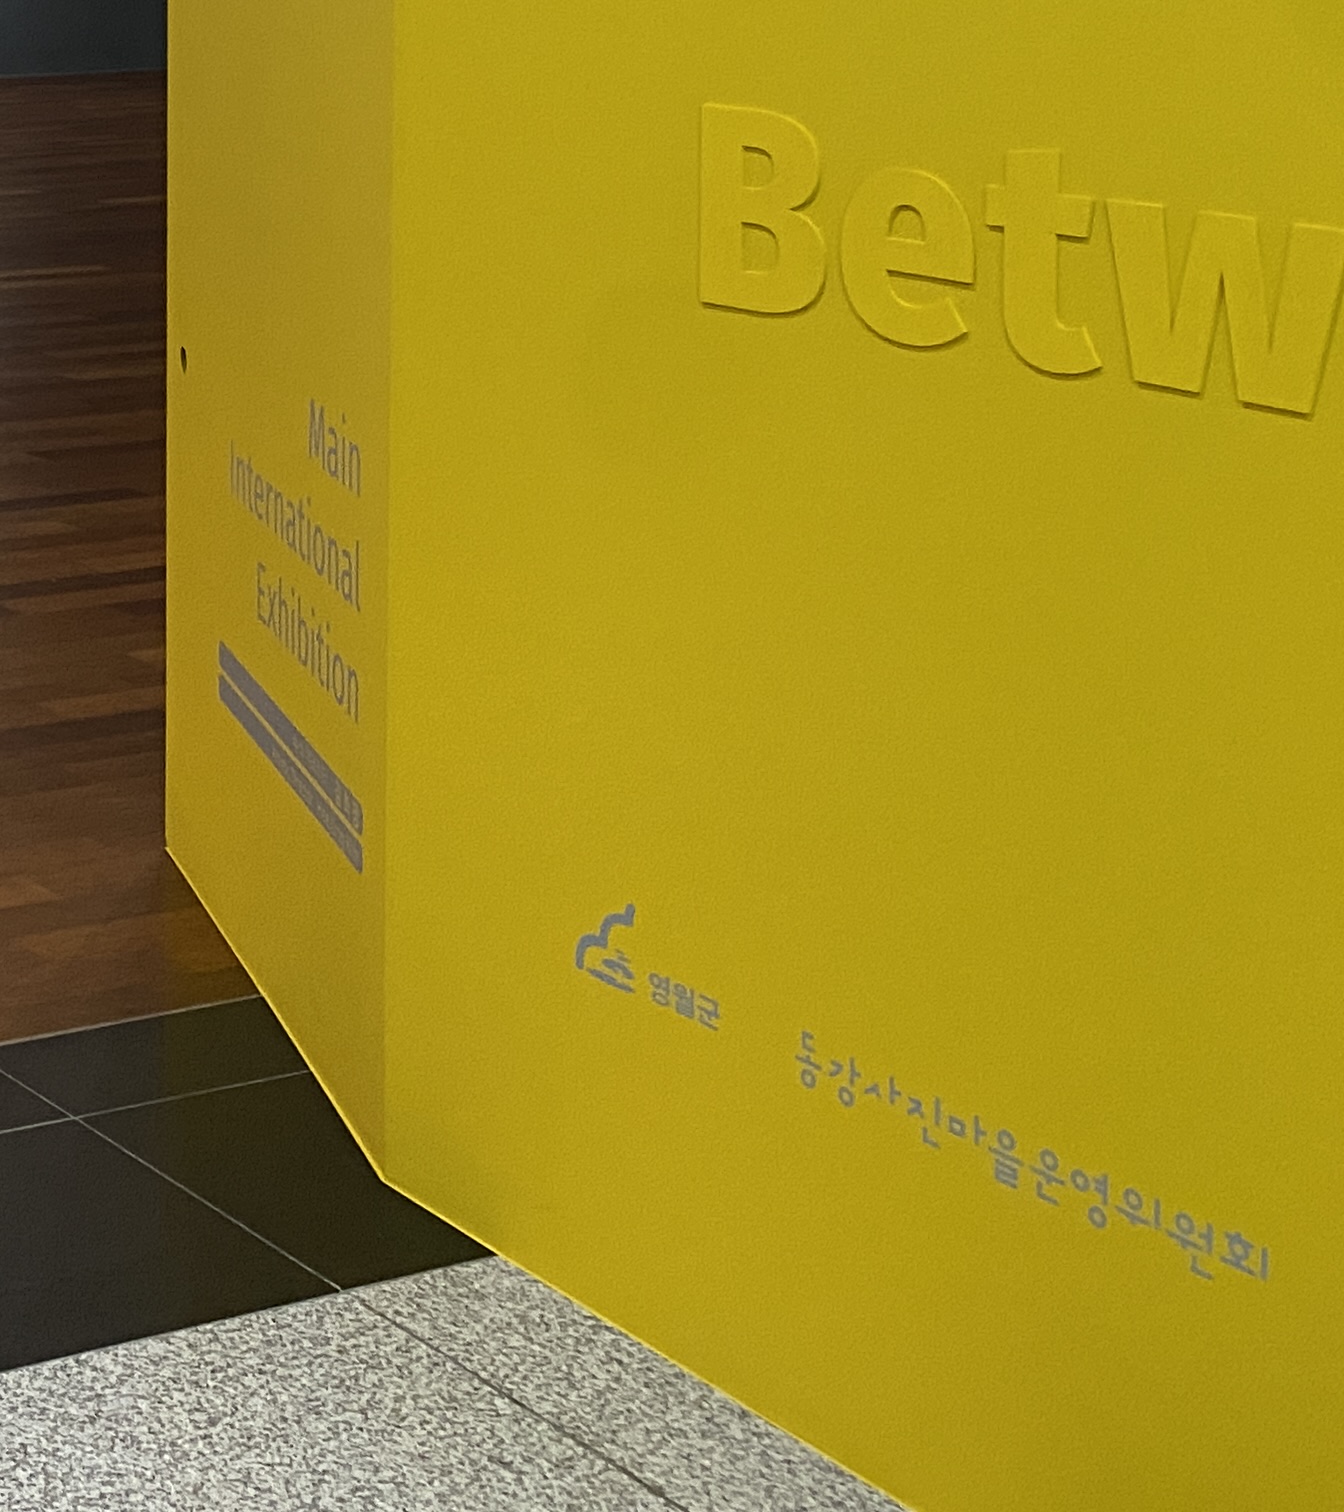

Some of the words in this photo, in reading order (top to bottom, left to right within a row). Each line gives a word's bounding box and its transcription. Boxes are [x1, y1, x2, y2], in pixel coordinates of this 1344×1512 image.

[698, 100, 1344, 422] Betw
[230, 439, 361, 613] International
[308, 398, 361, 498] Main
[256, 560, 359, 725] Exhibition
[648, 971, 721, 1032] 영월군
[796, 1030, 1269, 1282] 동강사진마을운영위원회
